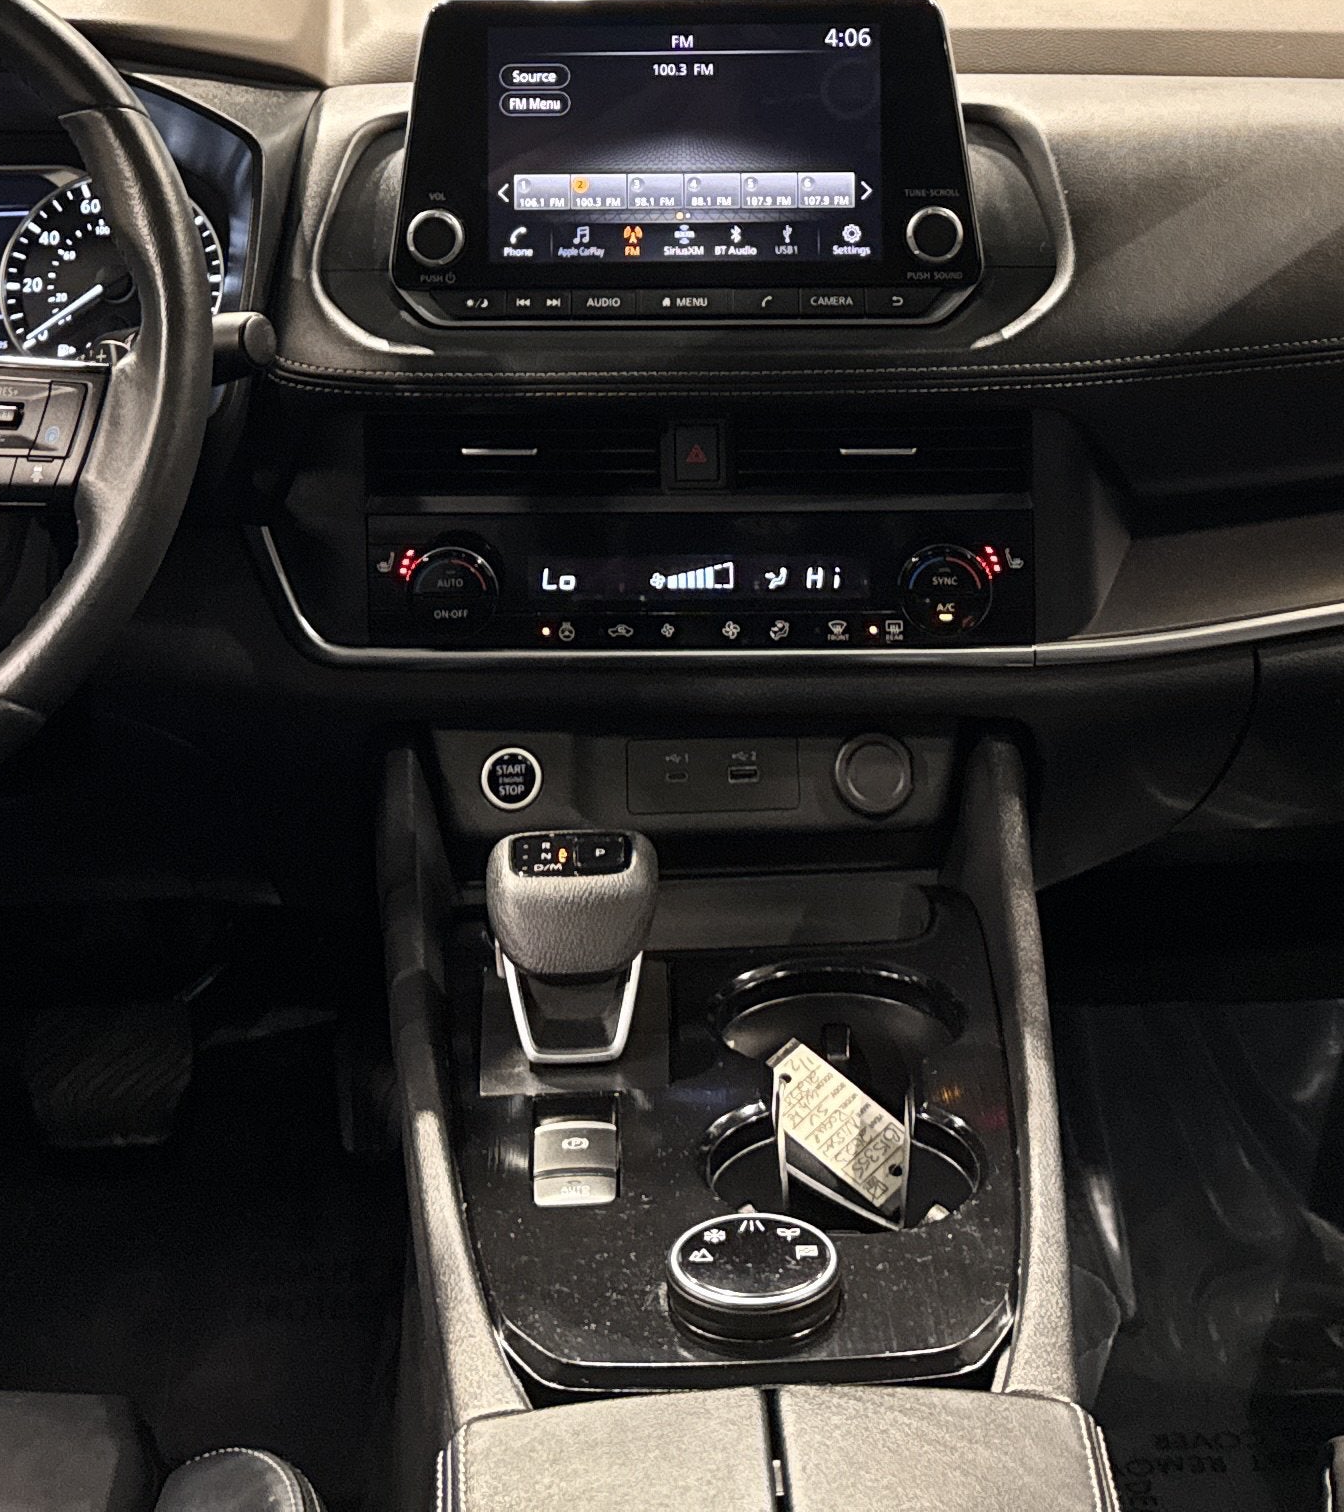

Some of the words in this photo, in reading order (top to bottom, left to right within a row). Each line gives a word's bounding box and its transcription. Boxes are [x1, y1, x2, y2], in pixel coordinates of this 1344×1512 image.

[671, 34, 694, 49] FM
[824, 27, 872, 48] 4:06
[652, 63, 688, 76] 100.3
[693, 62, 715, 76] FM
[512, 70, 557, 84] Source
[509, 97, 527, 110] FM
[529, 97, 561, 111] Menu
[428, 192, 446, 201] VOL
[549, 197, 565, 207] FM
[575, 197, 602, 207] 100.3
[606, 197, 621, 207] FM
[659, 196, 675, 207] FM
[716, 196, 732, 206] FM
[776, 195, 792, 206] FM
[834, 195, 849, 206] FM
[80, 198, 101, 214] 60
[95, 225, 110, 236] 100
[38, 230, 60, 246] 40
[62, 250, 76, 261] 60
[503, 247, 534, 257] Phone
[557, 246, 578, 258] Apple
[579, 246, 605, 258] CarPlay
[624, 246, 641, 257] FM
[663, 245, 704, 256] SiriusXM
[714, 245, 726, 256] BT
[728, 245, 758, 256] Audio
[774, 245, 798, 255] USB1
[832, 244, 871, 257] Settings
[420, 274, 443, 283] PUSH
[907, 271, 931, 281] PUSH
[933, 270, 963, 280] SOUND
[22, 277, 43, 293] 20
[586, 297, 621, 308] AUDIO
[676, 296, 708, 307] MENU
[810, 296, 854, 306] CAMERA
[437, 578, 464, 588] AUTO
[541, 567, 576, 591] Lo
[806, 566, 841, 589] Hi
[932, 576, 958, 586] SYNC
[936, 602, 955, 612] A/C
[496, 763, 526, 775] START
[499, 784, 525, 795] STOP
[541, 841, 551, 850] R
[541, 852, 551, 860] N
[595, 848, 606, 857] P
[534, 863, 562, 872] D/M
